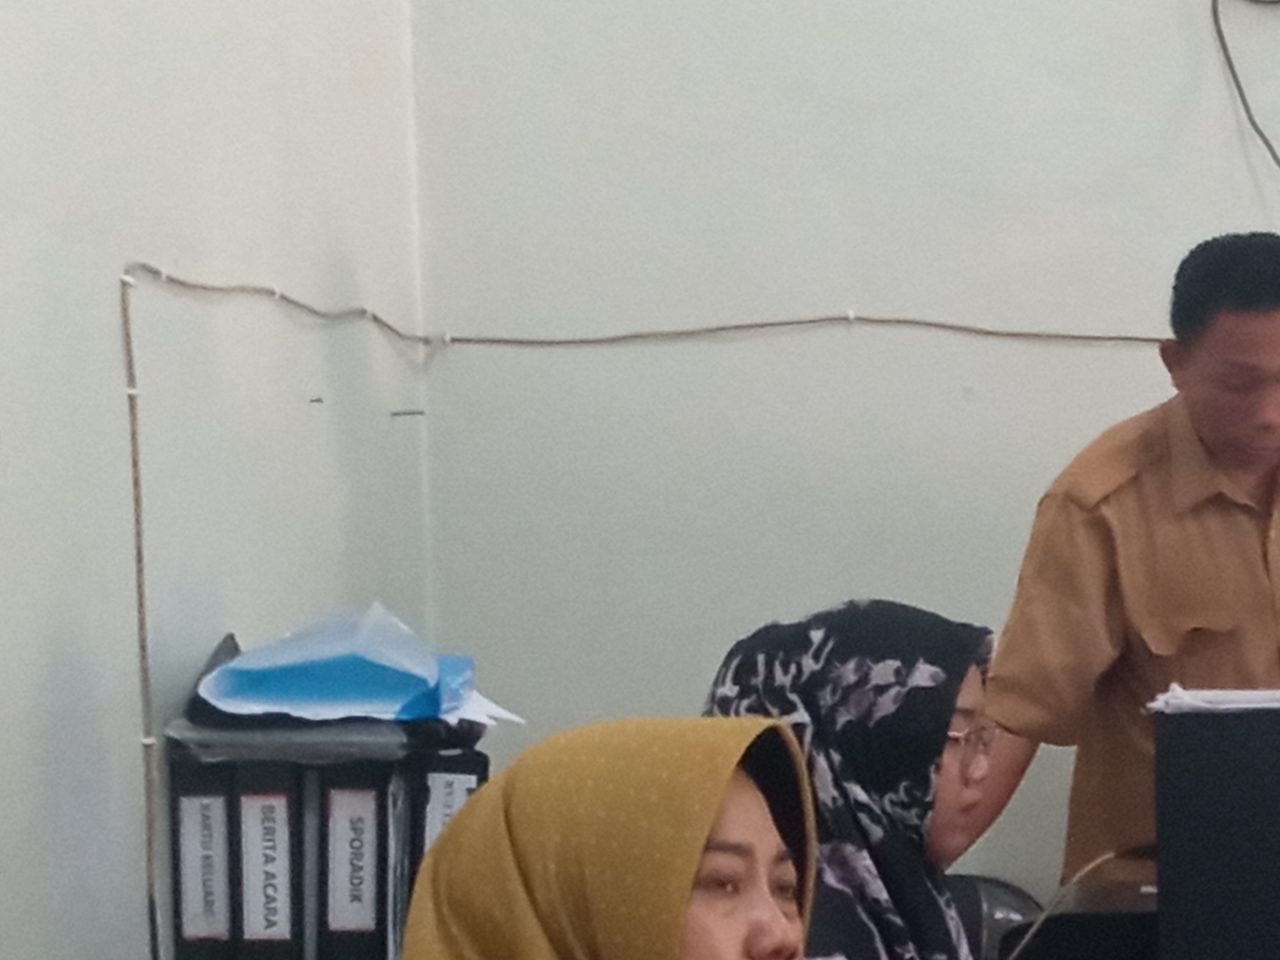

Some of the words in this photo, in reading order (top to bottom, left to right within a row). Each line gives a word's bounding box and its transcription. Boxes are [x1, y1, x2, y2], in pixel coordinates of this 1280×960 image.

[260, 804, 278, 866] BERITA
[349, 816, 366, 904] SPORADIK
[201, 855, 216, 926] KELUAR
[262, 870, 279, 930] ACARA
